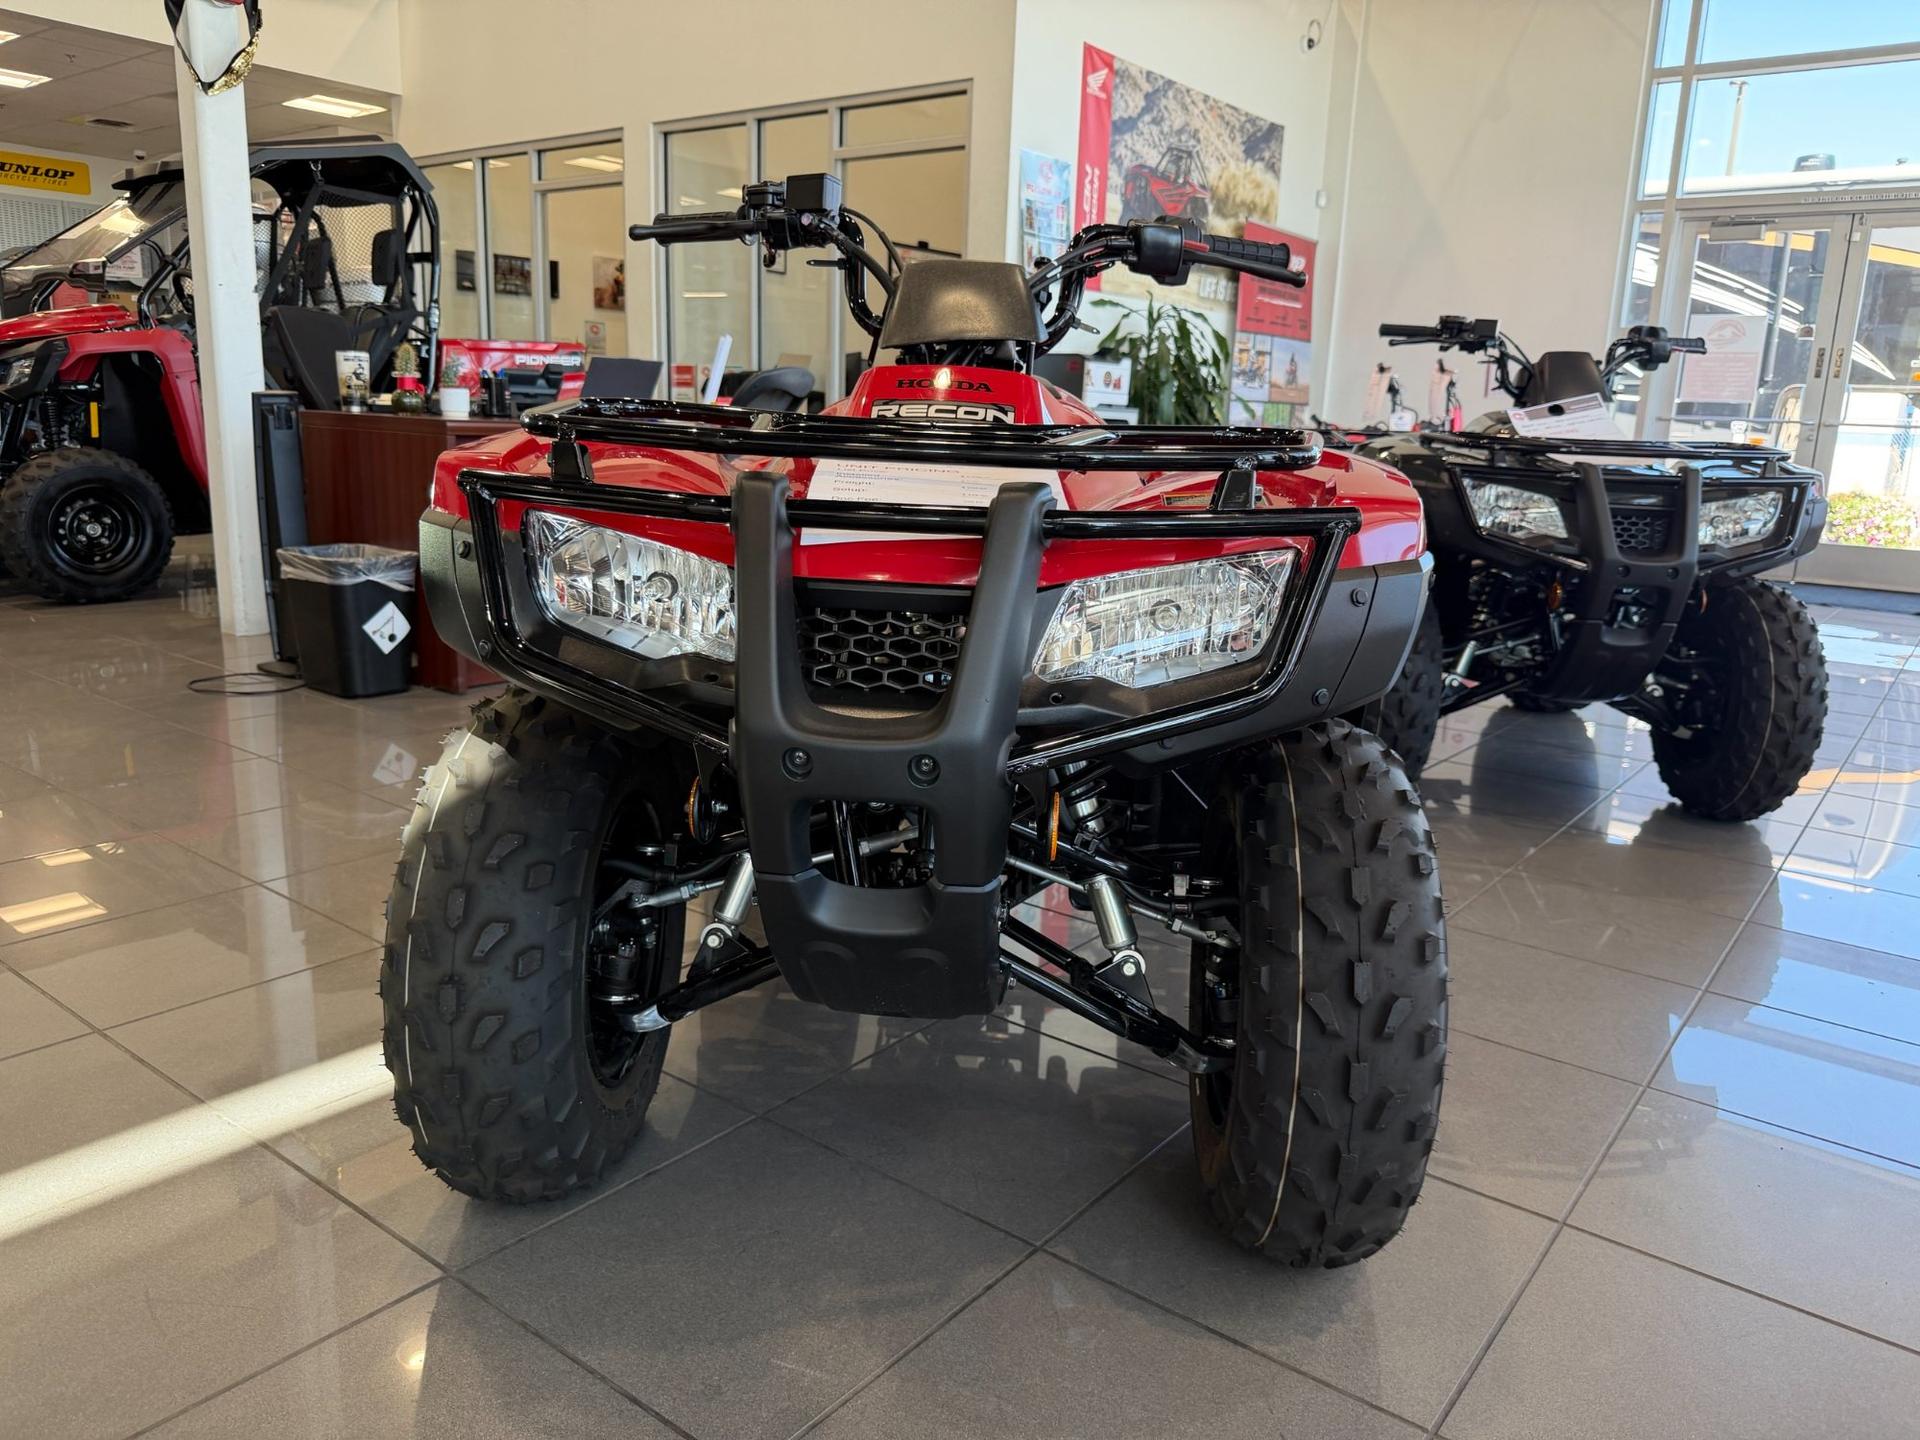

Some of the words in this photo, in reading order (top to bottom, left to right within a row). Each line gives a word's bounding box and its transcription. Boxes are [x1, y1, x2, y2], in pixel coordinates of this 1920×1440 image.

[0, 161, 75, 179] UNLOP
[896, 378, 993, 393] HODA
[871, 404, 1016, 425] RECON
